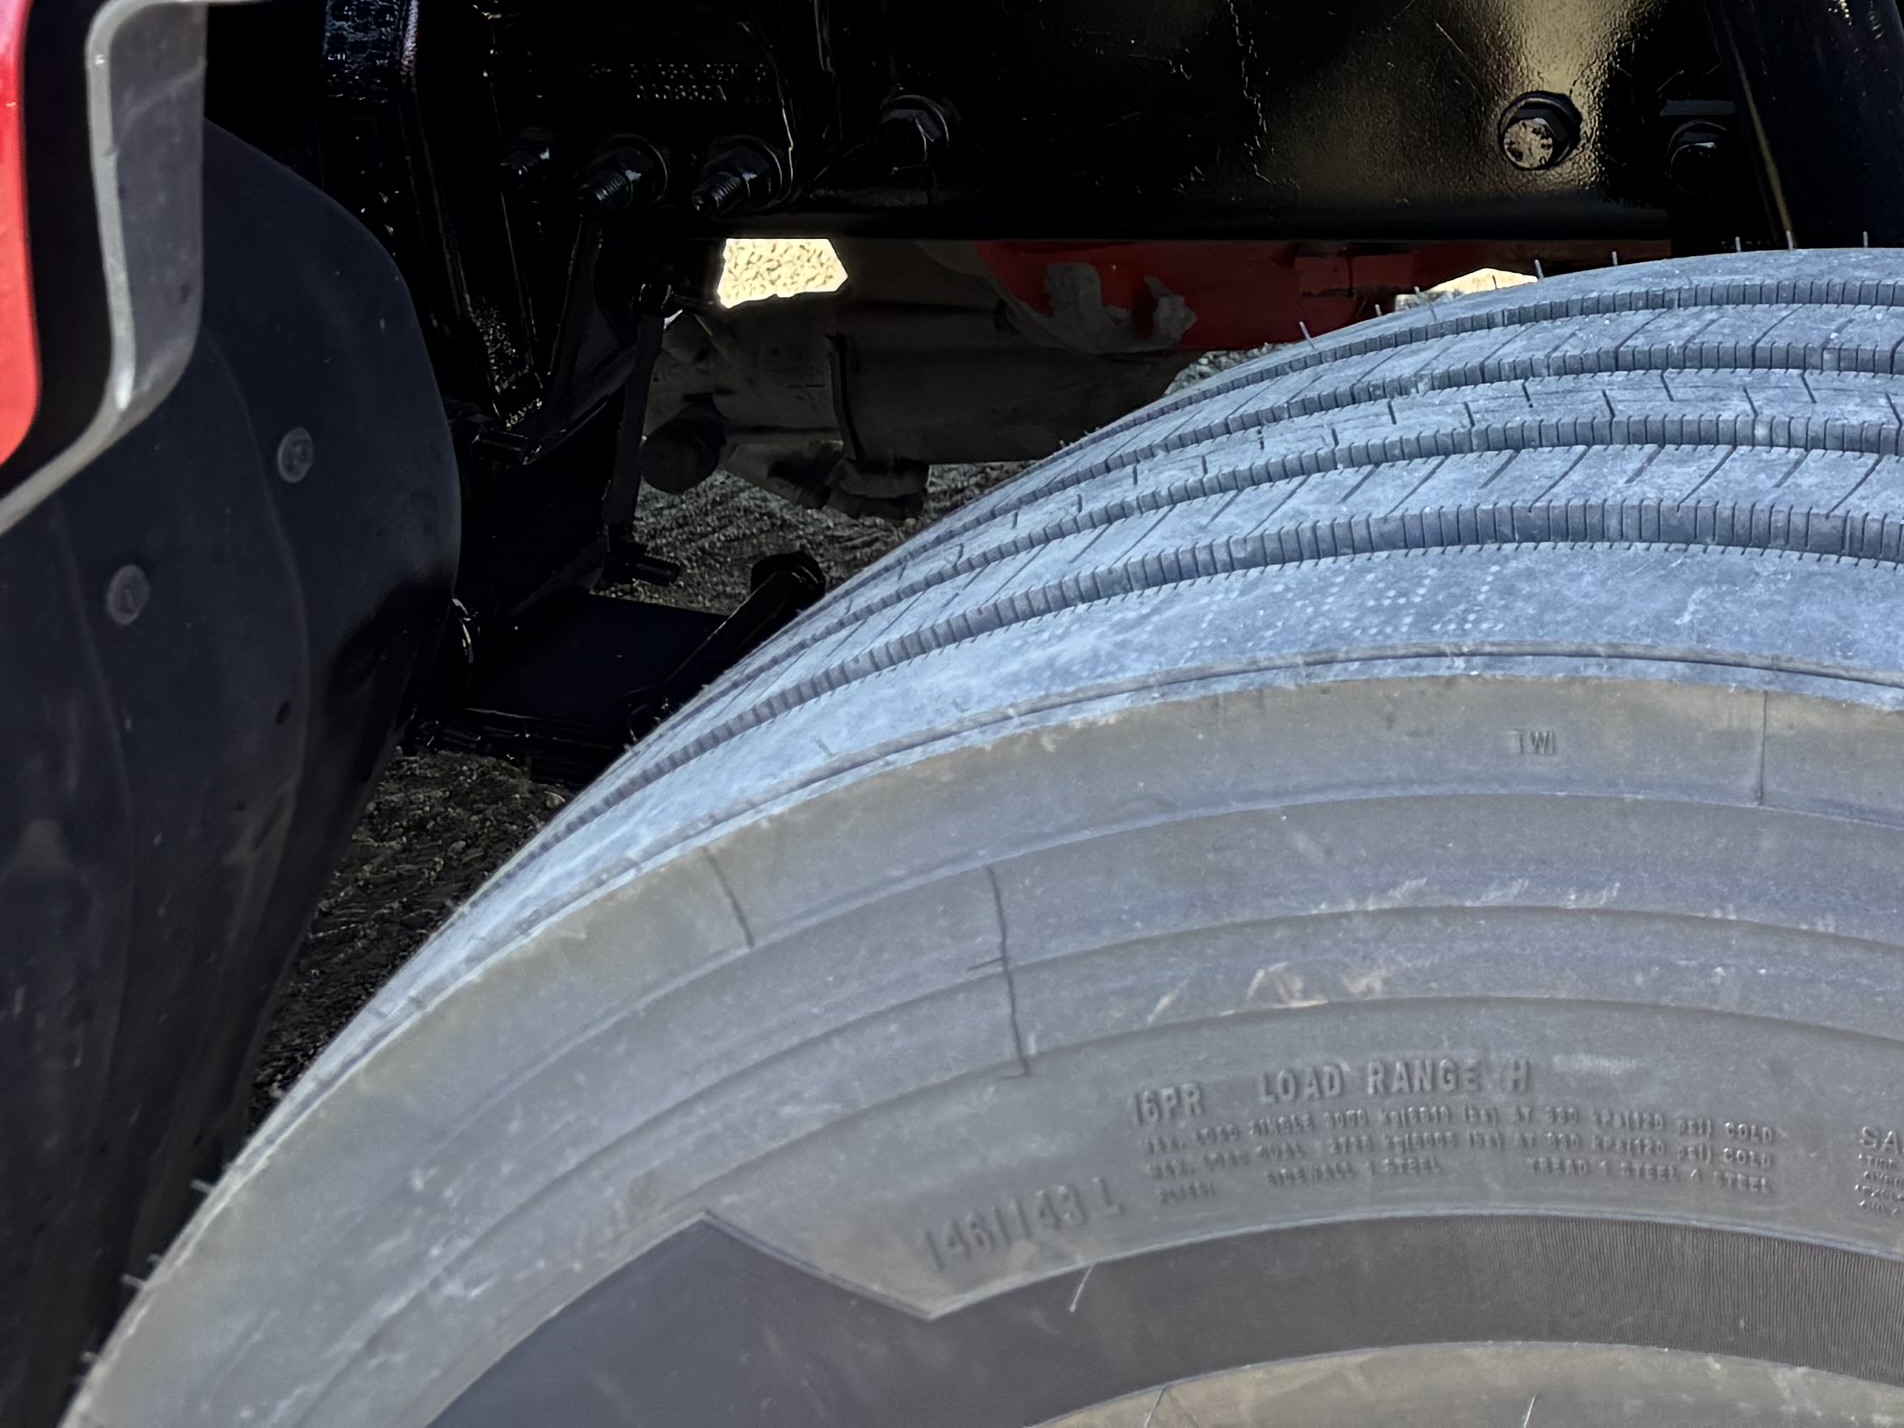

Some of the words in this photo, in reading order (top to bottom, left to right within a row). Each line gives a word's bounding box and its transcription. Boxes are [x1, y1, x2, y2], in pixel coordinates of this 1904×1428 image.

[1511, 728, 1556, 757] TWI
[1132, 1082, 1204, 1126] 16PR
[1258, 1063, 1346, 1105] LOAD
[1367, 1058, 1481, 1095] RANGE
[1507, 1058, 1530, 1093] H
[1724, 1120, 1774, 1143] COLD
[1721, 1146, 1771, 1169] COLD
[1382, 1156, 1441, 1174] STEEL
[1526, 1156, 1589, 1175] TREAD
[1619, 1160, 1678, 1181] STEEL
[1713, 1171, 1771, 1193] STEEL
